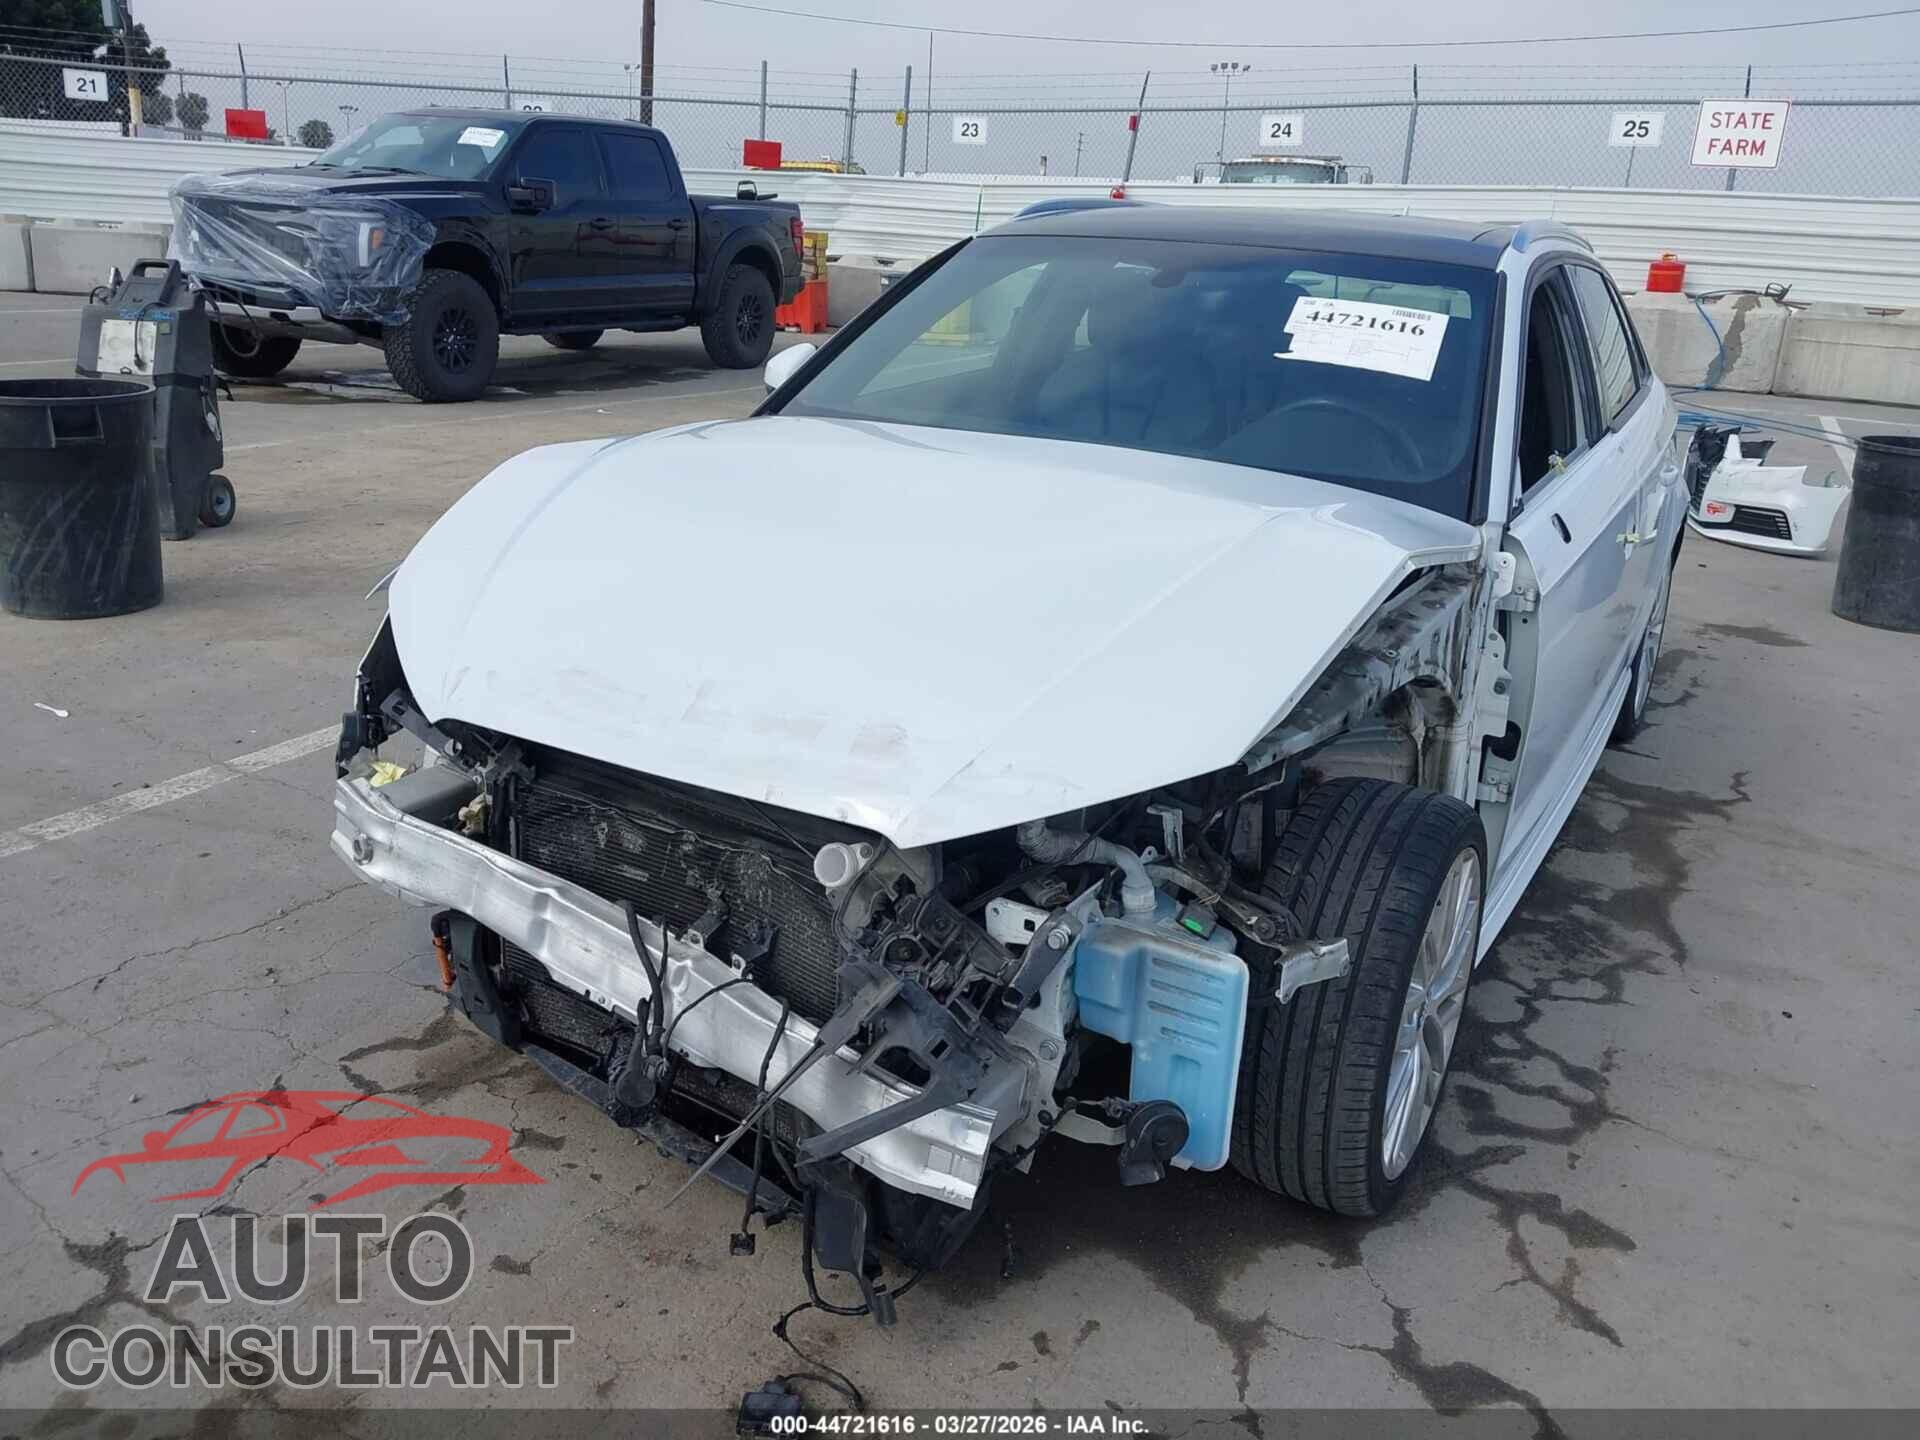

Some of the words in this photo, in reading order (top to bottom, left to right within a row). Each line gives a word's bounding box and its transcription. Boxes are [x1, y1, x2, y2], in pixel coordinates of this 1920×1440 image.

[76, 77, 97, 93] 21
[1622, 120, 1650, 138] 25
[1710, 112, 1774, 129] STATE
[961, 122, 979, 137] 23
[1270, 122, 1292, 138] 24
[1707, 138, 1766, 156] FARM
[1305, 310, 1425, 337] 44721616
